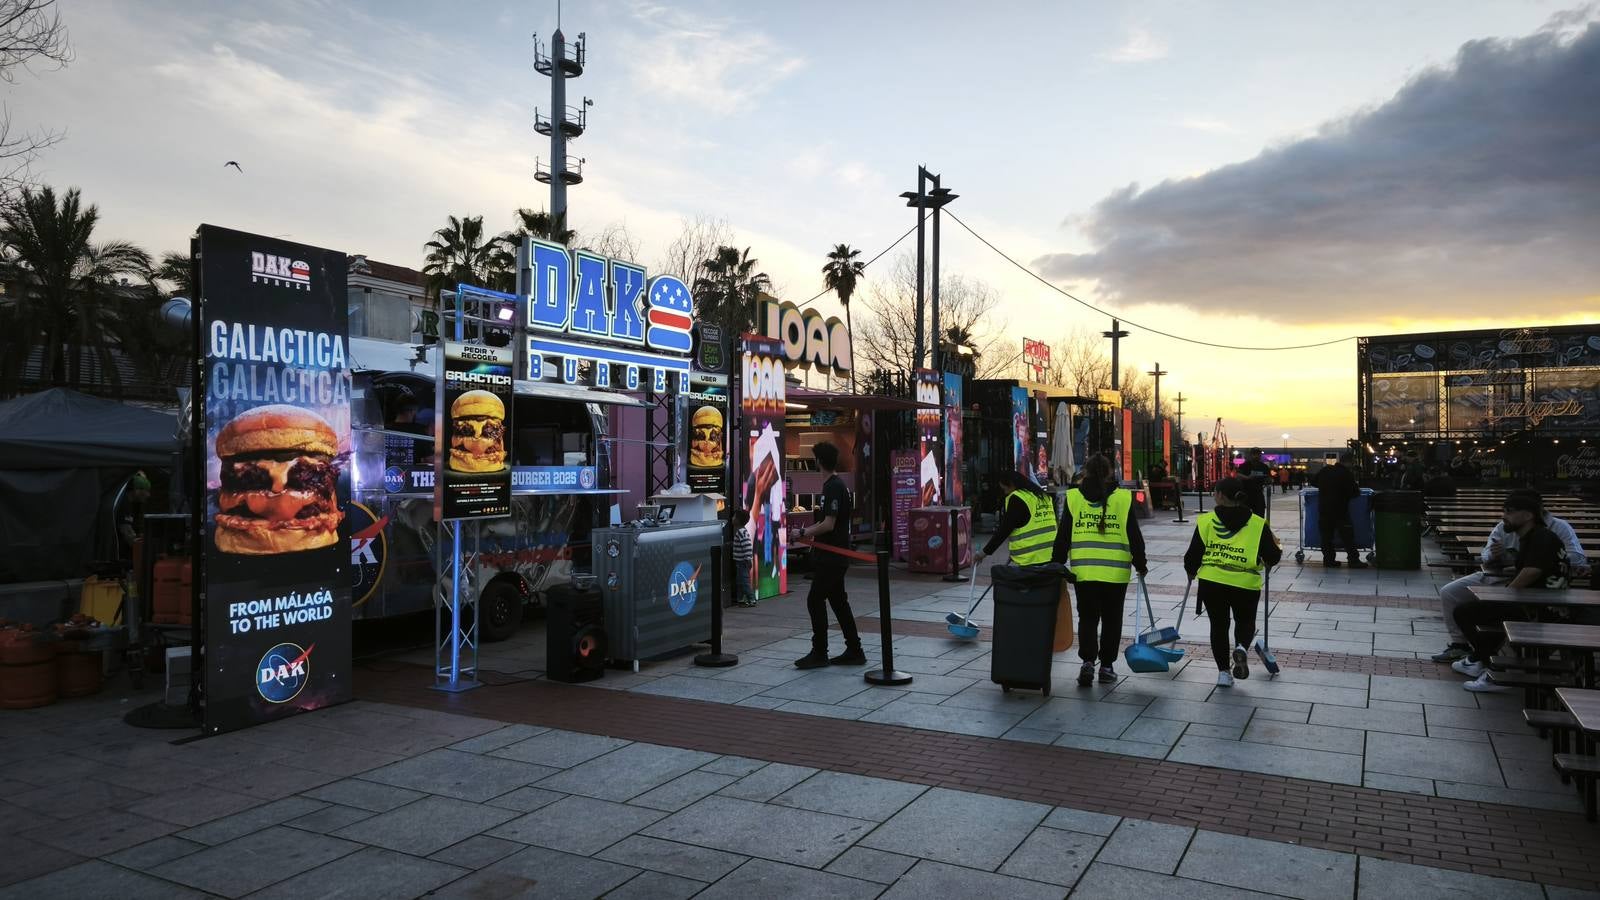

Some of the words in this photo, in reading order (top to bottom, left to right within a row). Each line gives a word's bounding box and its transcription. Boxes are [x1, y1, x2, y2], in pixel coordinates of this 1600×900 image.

[252, 251, 291, 277] DAK
[252, 276, 311, 291] BURGER
[528, 239, 647, 345] DAK
[210, 320, 346, 368] GALACTICA
[464, 346, 487, 354] PEDIR
[461, 352, 498, 361] RECOGER
[446, 370, 511, 385] GALACTICA
[528, 352, 691, 394] BURGER
[212, 362, 347, 404] GALACTICA
[689, 391, 727, 402] GALACTICA
[385, 475, 404, 483] DAK
[512, 471, 551, 485] BURGER
[553, 471, 577, 485] 2025
[1075, 520, 1085, 528] de
[1212, 551, 1248, 563] primera
[671, 581, 697, 597] DAK
[229, 600, 272, 618] FROM
[275, 590, 333, 611] MÁLAGA
[230, 618, 252, 634] TO
[254, 614, 280, 631] THE
[283, 605, 333, 625] WORLD
[261, 660, 305, 684] DAK
